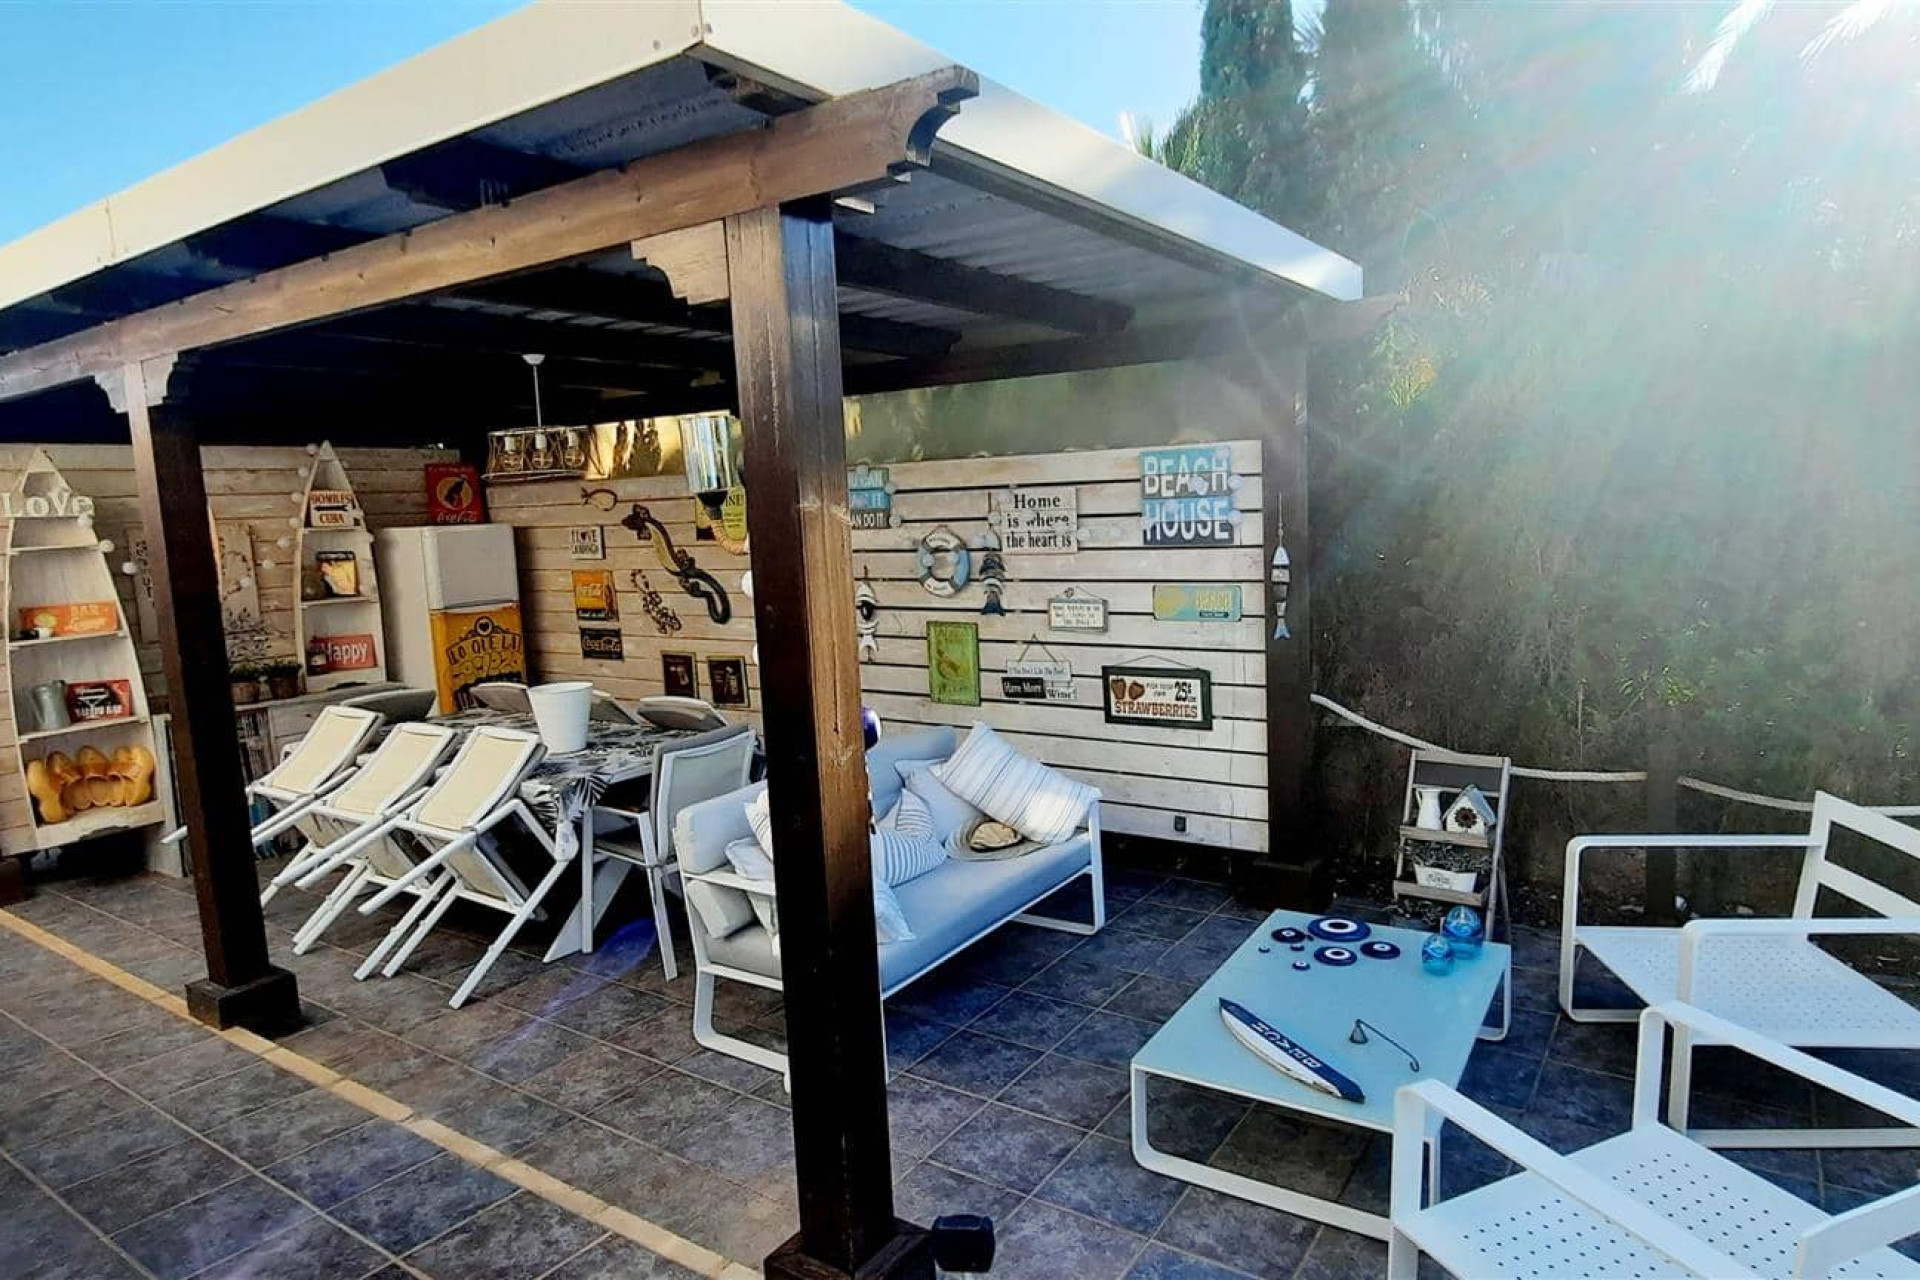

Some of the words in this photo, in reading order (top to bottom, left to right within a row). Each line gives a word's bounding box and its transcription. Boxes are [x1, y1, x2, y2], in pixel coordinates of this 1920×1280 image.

[1143, 453, 1229, 497] BEACH
[1014, 493, 1061, 509] Home
[1006, 513, 1020, 528] is
[1026, 511, 1070, 527] where
[1144, 499, 1230, 541] HOUSE
[1006, 530, 1025, 548] the
[1027, 530, 1057, 548] heart
[1061, 533, 1072, 548] is
[1115, 700, 1198, 718] STRAWBERRIES
